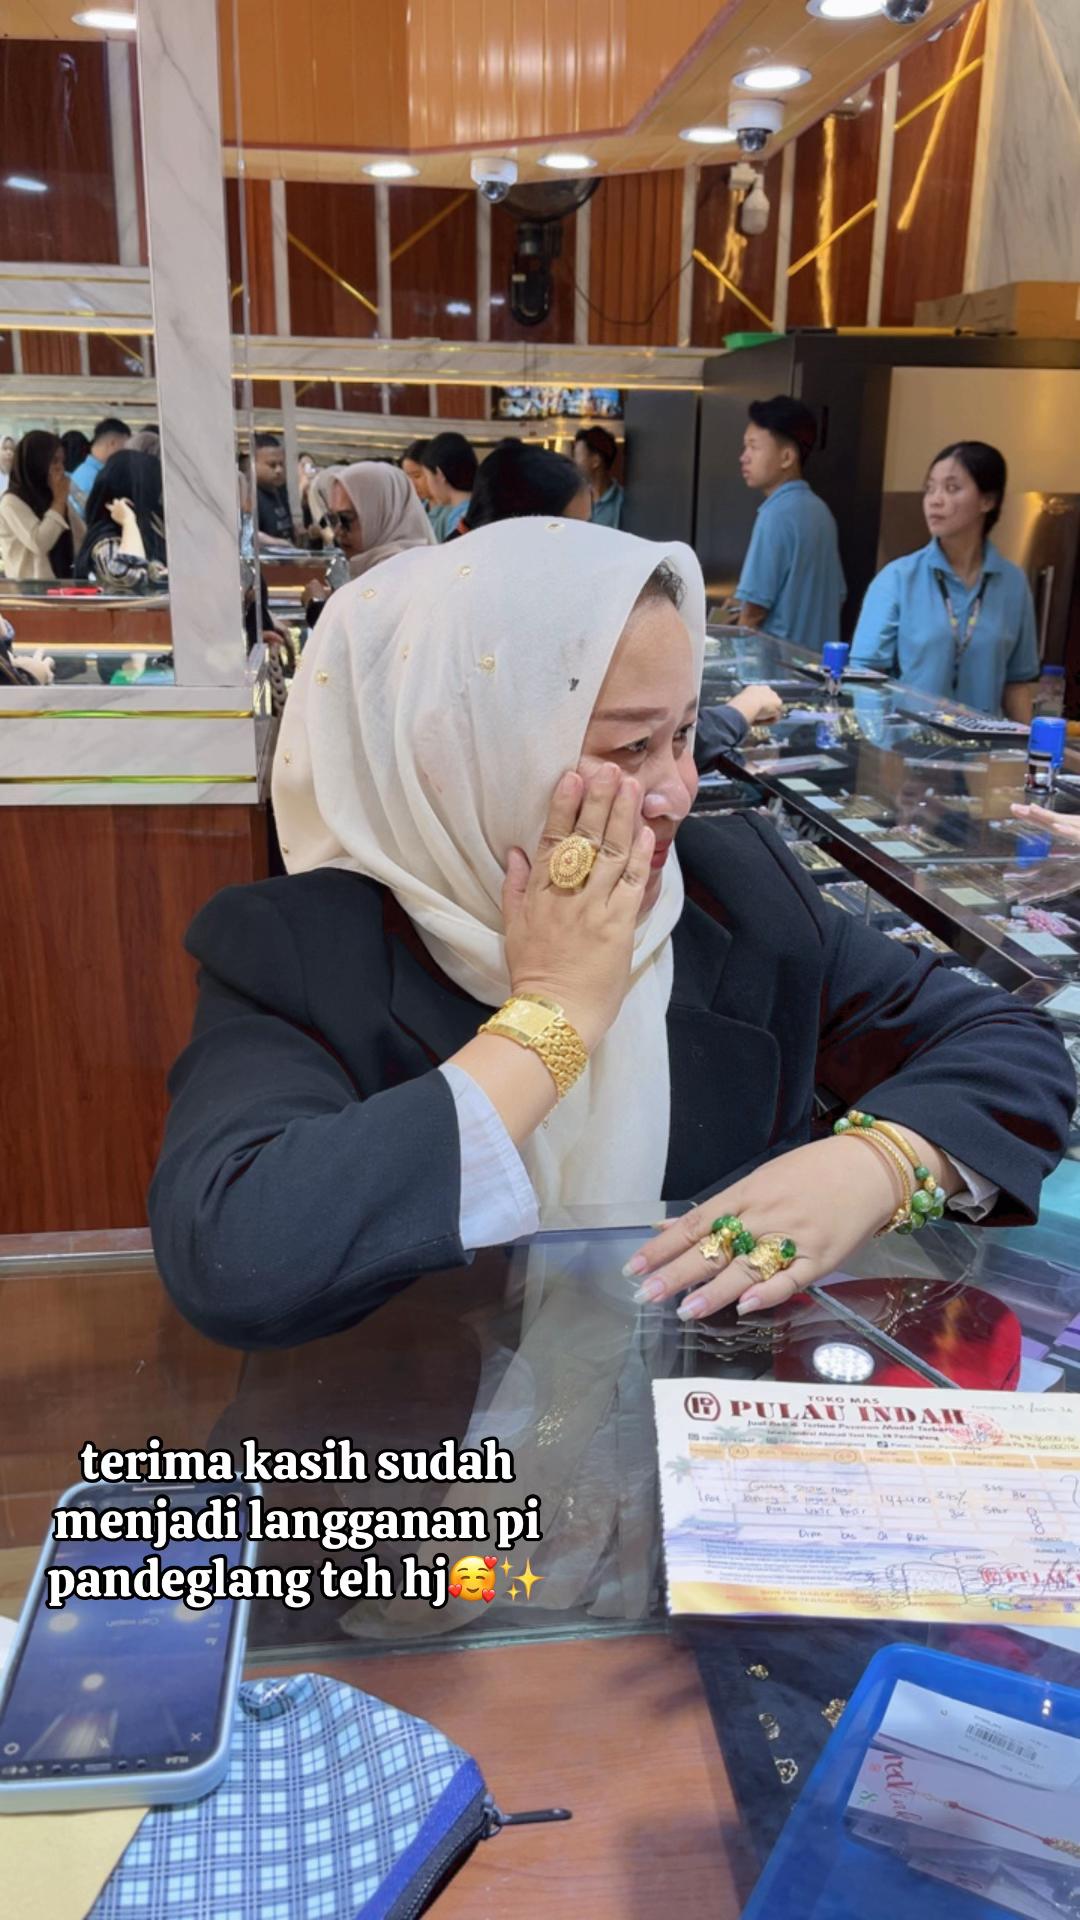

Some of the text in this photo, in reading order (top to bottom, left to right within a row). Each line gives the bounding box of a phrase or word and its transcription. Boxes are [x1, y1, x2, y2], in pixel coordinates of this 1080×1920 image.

[807, 1395, 880, 1404] TOKO MAS
[729, 1399, 846, 1421] PULAU
[858, 1405, 967, 1426] INDAH
